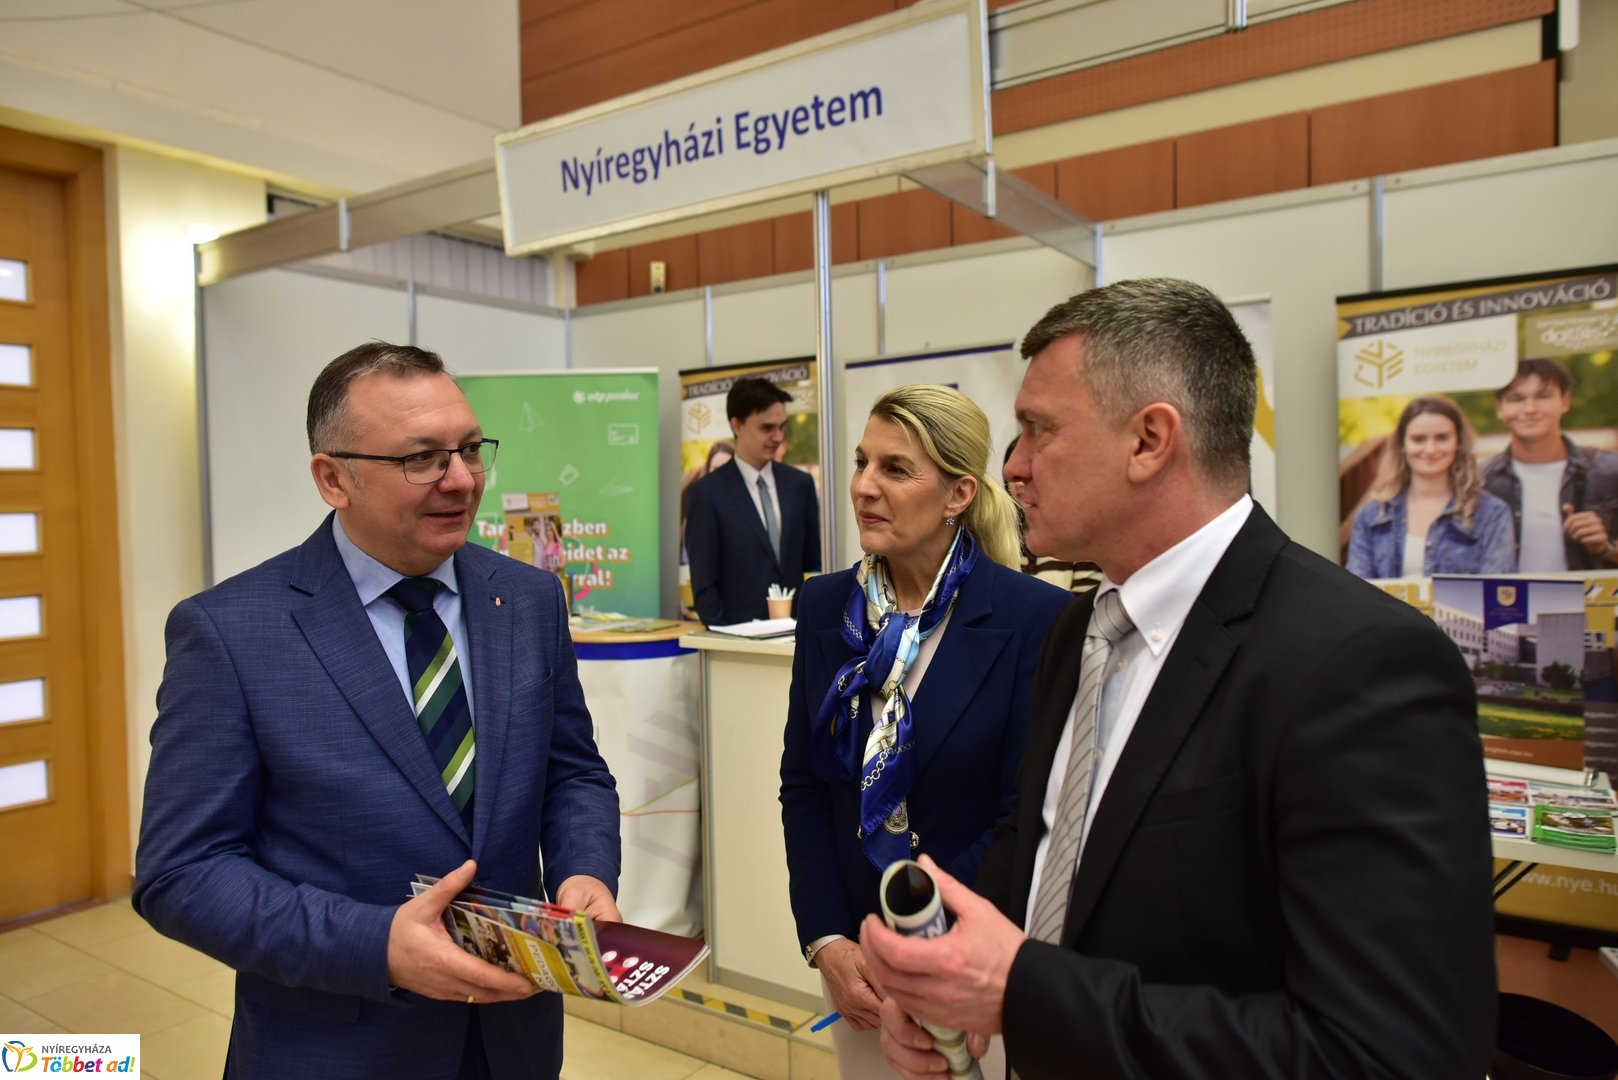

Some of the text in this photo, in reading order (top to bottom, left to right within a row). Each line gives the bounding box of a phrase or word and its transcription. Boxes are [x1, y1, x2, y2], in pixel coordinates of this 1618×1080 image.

[560, 85, 885, 197] Nyíregyházi Egyetem
[1452, 300, 1474, 320] ÉS
[1480, 280, 1611, 314] INNOVÁCIÓ
[476, 517, 608, 536] Tar zben
[607, 547, 630, 561] az
[1521, 872, 1618, 897] ww.nye.h
[615, 960, 655, 994] SZTÁ
